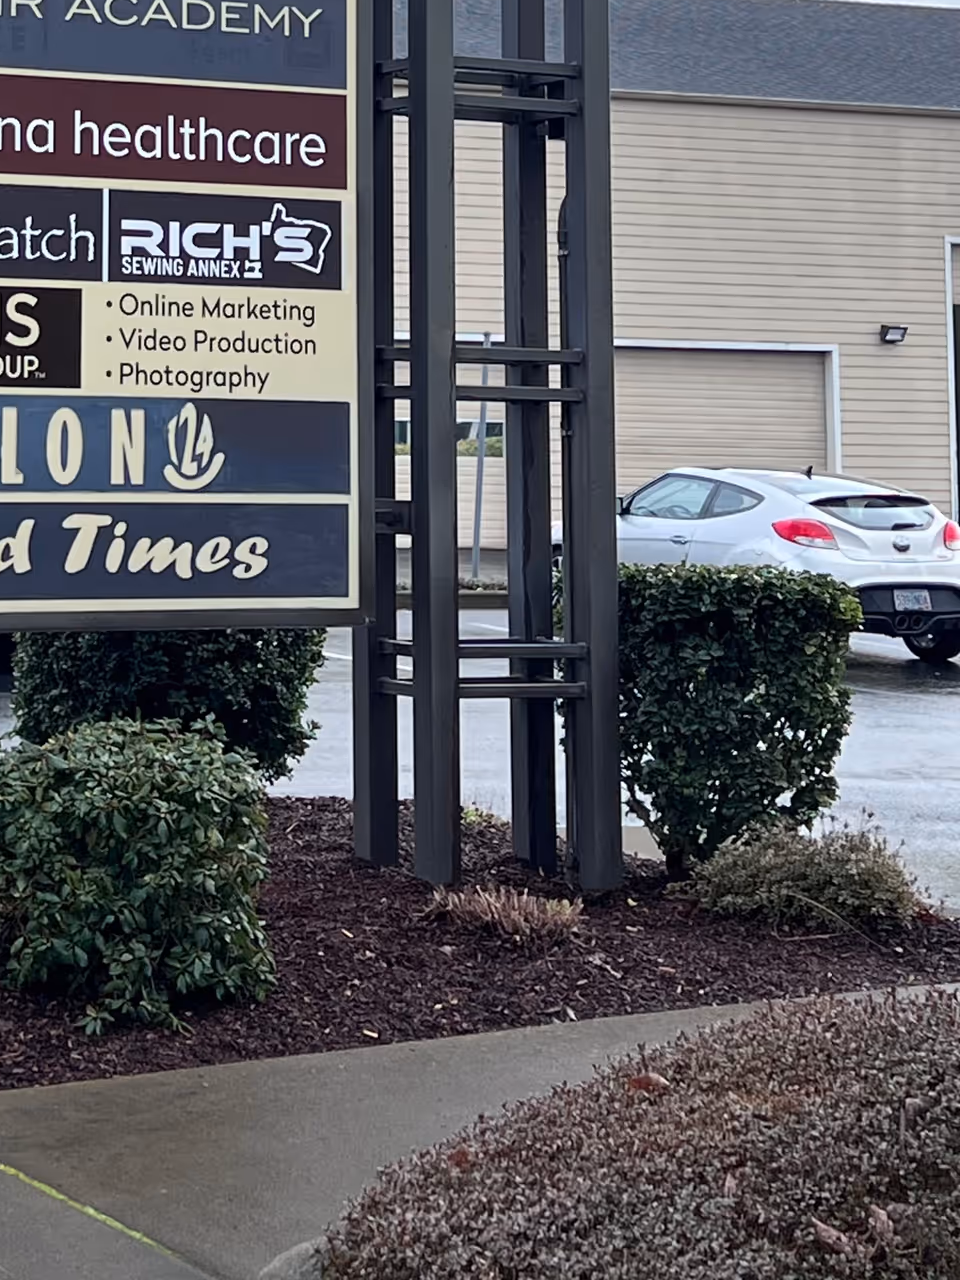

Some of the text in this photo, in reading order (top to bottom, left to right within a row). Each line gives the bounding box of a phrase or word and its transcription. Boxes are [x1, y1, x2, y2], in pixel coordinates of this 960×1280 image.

[75, 110, 325, 166] healthcare
[120, 219, 314, 263] RICH'S
[122, 256, 240, 278] SEWING ANNEX
[120, 293, 314, 327] Online Marketing
[119, 328, 316, 354] Video Production
[120, 363, 269, 394] Photography
[62, 514, 268, 578] Times
